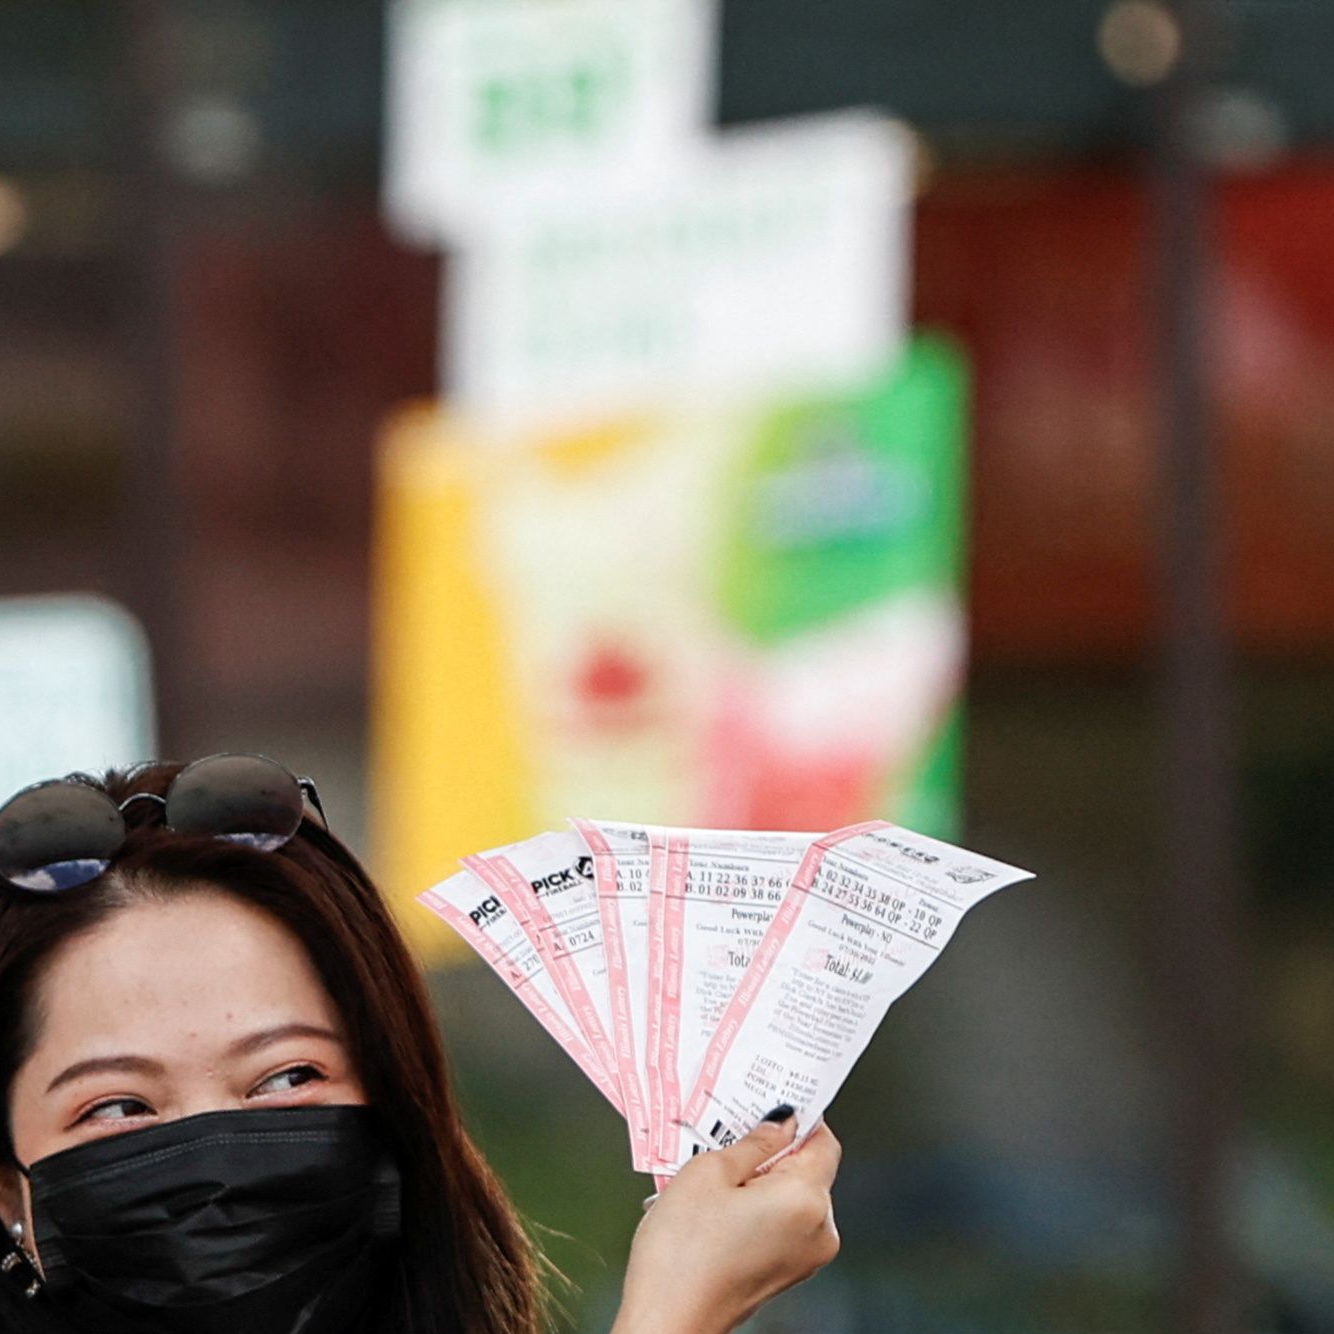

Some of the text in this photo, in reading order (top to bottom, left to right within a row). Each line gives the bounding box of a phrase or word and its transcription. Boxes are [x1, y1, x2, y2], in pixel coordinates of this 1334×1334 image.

[531, 869, 574, 894] PICK
[630, 869, 642, 879] 10
[700, 871, 712, 882] 11
[717, 873, 730, 884] 22
[736, 875, 747, 885] 36
[752, 876, 765, 886] 37
[768, 878, 782, 888] 66
[629, 881, 642, 892] 02
[684, 882, 781, 900] B. 01 02 09 38 66
[826, 870, 838, 883] 02
[839, 875, 851, 888] 32
[852, 881, 864, 894] 34
[865, 887, 877, 900] 35
[878, 893, 891, 905] 38
[891, 898, 906, 911] QP
[914, 908, 926, 921] 10
[928, 915, 942, 927] QP
[822, 882, 834, 895] 24
[835, 888, 848, 899] 27
[848, 894, 859, 907] 55
[861, 899, 873, 912] 56
[874, 905, 886, 918] 64
[888, 911, 902, 924] QP
[909, 920, 921, 933] 22
[923, 927, 937, 940] QP
[568, 930, 595, 946] 0724
[841, 913, 874, 937] Powerplay
[882, 931, 892, 944] NO
[824, 954, 850, 977] Total:
